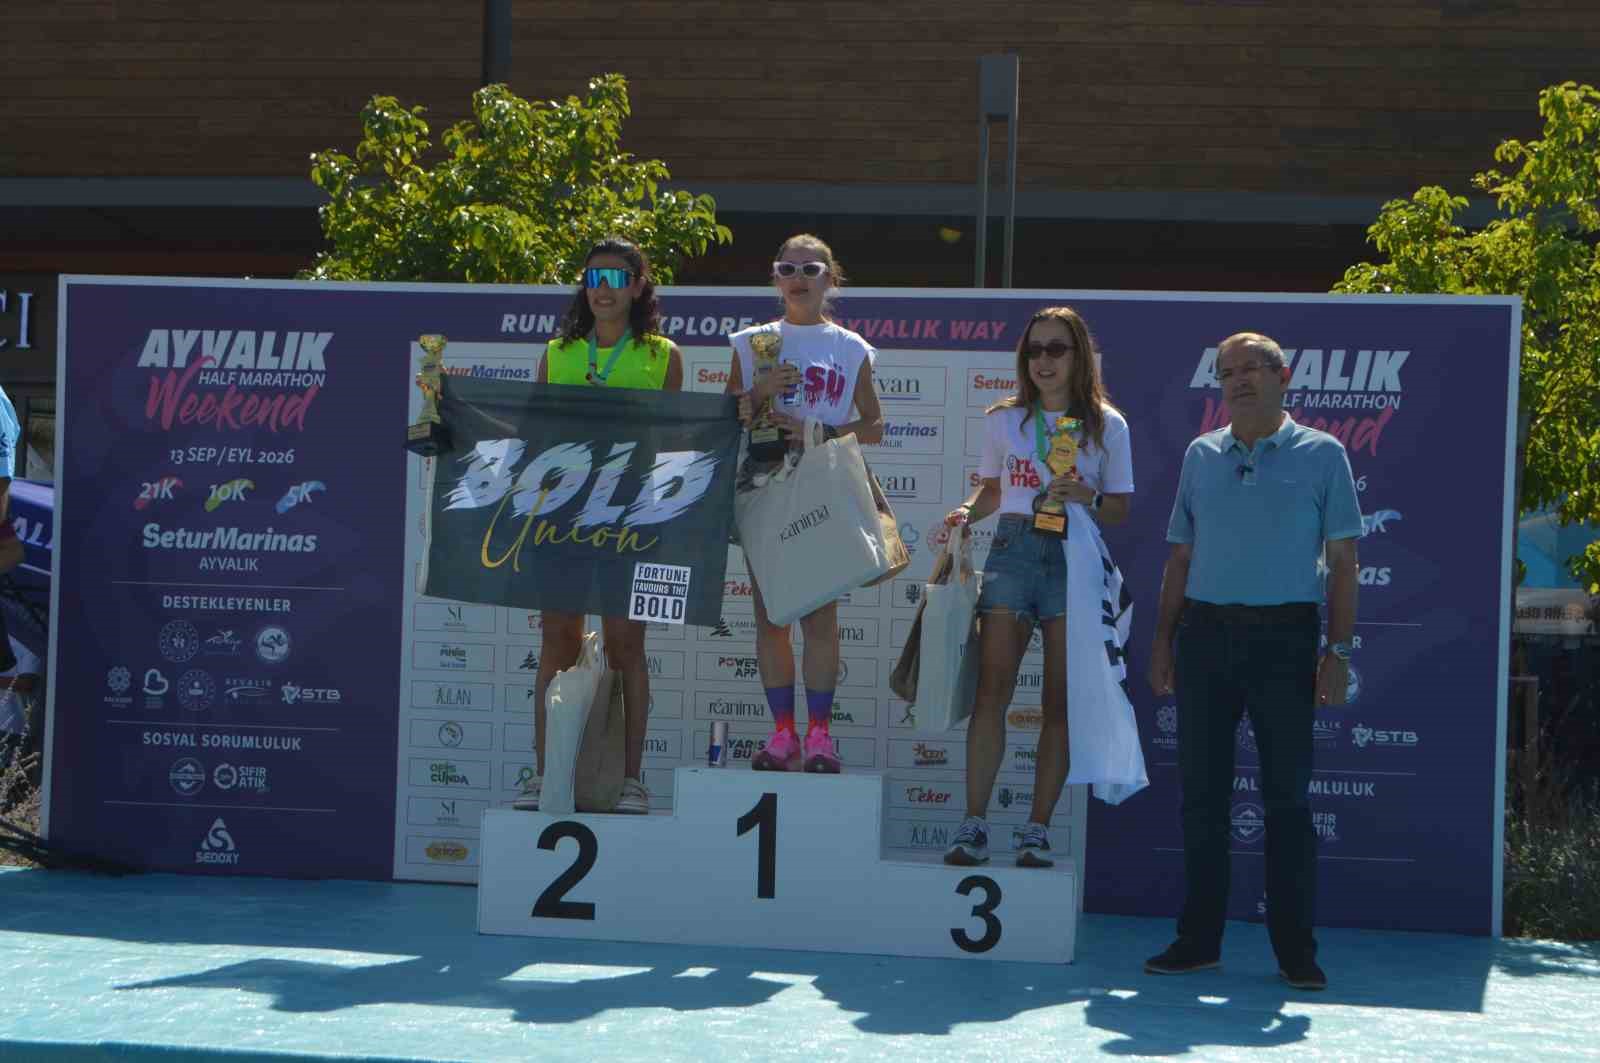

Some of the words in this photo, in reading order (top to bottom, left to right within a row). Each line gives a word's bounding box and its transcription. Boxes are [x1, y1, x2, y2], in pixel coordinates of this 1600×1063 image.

[836, 319, 940, 338] YVALIK
[947, 320, 1007, 340] WAY
[137, 329, 334, 371] AYVALIK
[199, 372, 236, 386] HALF
[239, 373, 326, 387] MARATHON
[1190, 347, 1410, 391] AALIK
[872, 370, 921, 393] ivan
[144, 355, 322, 432] Weekend
[1282, 393, 1302, 408] LF
[1304, 394, 1401, 410] MARATHON
[169, 449, 185, 465] 13
[258, 448, 295, 464] 2026
[139, 478, 176, 499] 21K
[208, 480, 248, 501] 10K
[442, 437, 722, 528] BOLD
[287, 481, 313, 506] 5K
[142, 523, 317, 552] SeturMarinas
[480, 485, 658, 573] Union
[199, 556, 259, 571] AYVALIK
[639, 566, 689, 582] FORTUNE
[163, 595, 291, 612] DESTEKLEYENLER
[634, 595, 684, 619] BOLD
[735, 668, 757, 678] APP
[302, 688, 341, 700] STB
[143, 731, 197, 747] SOSYAL
[201, 734, 303, 750] SORUMLULUK
[1374, 730, 1419, 743] STB
[239, 766, 267, 777] SIFIR
[239, 777, 266, 788] ATIK
[1312, 812, 1336, 824] IFIR
[1313, 823, 1336, 837] TIK
[736, 792, 777, 899] 1
[531, 821, 598, 920] 2
[950, 875, 1002, 953] 3
